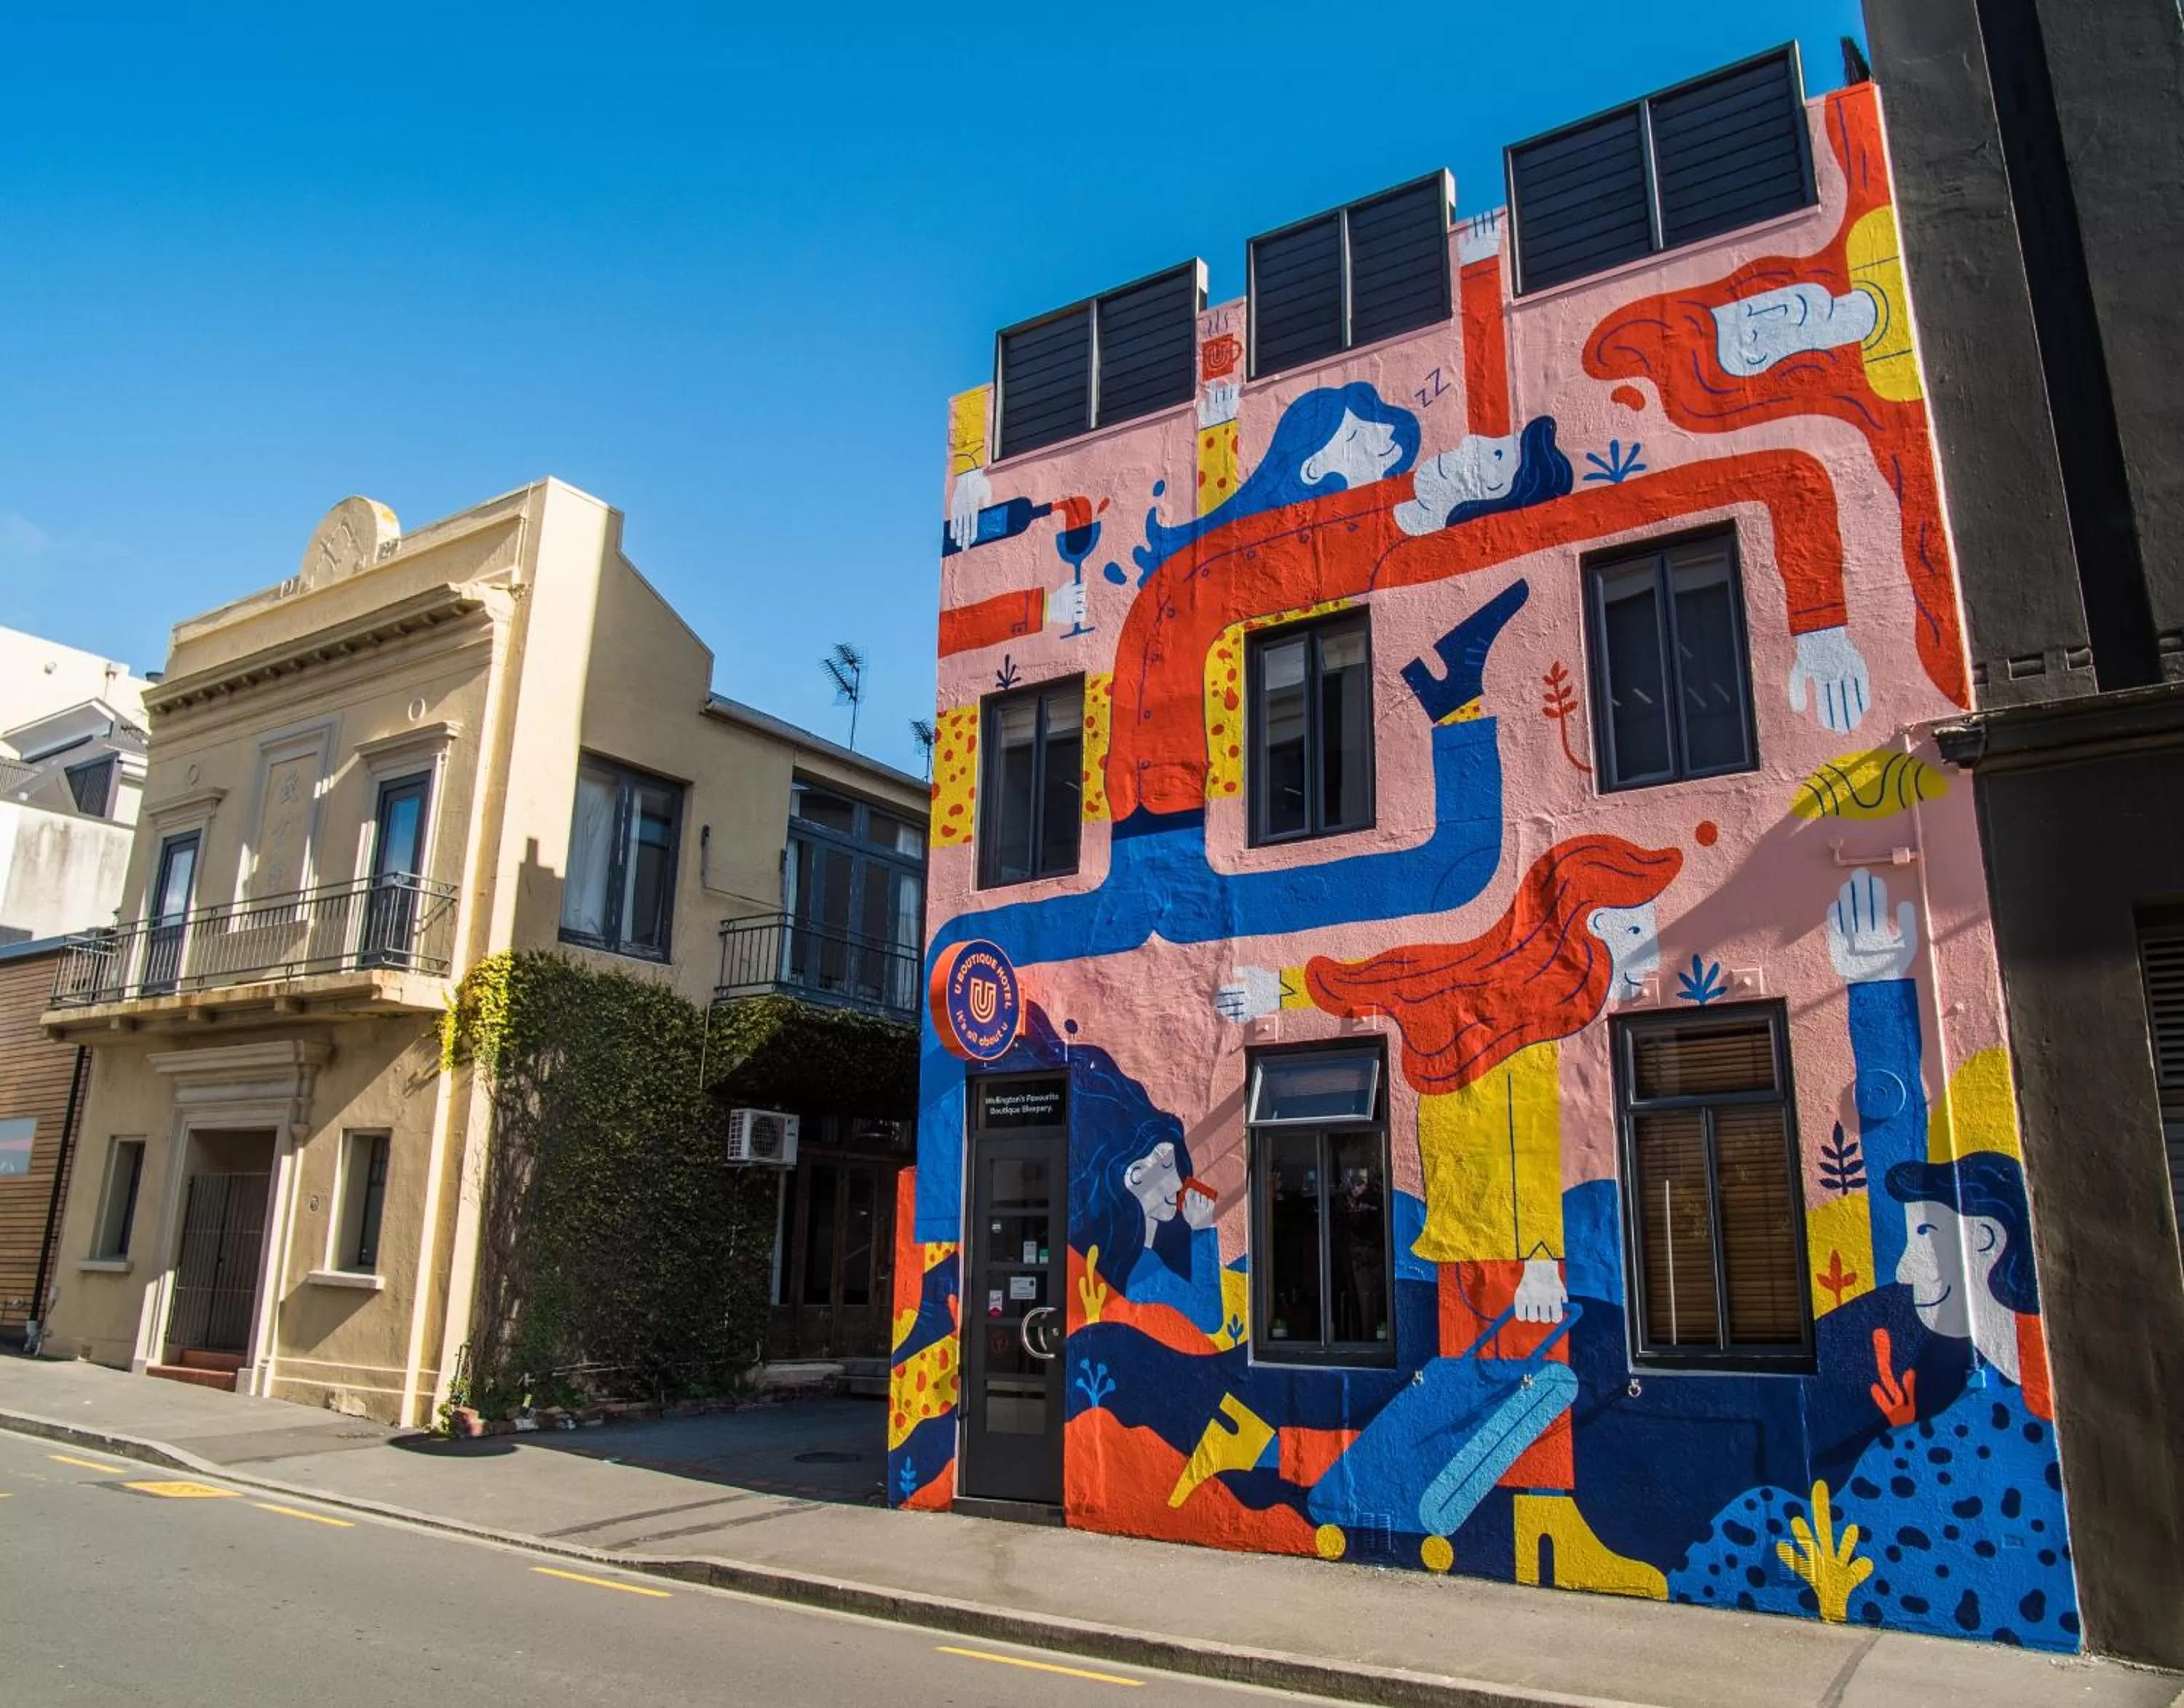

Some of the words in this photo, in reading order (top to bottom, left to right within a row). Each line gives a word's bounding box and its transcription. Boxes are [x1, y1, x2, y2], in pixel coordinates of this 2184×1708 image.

[957, 953, 997, 983] BOUTIQUE
[954, 986, 962, 995] U
[996, 967, 1013, 1010] HOTEL
[970, 977, 997, 1024] U
[978, 1031, 1004, 1046] about
[1026, 1092, 1059, 1102] Favourite
[990, 1106, 1021, 1115] Boutique
